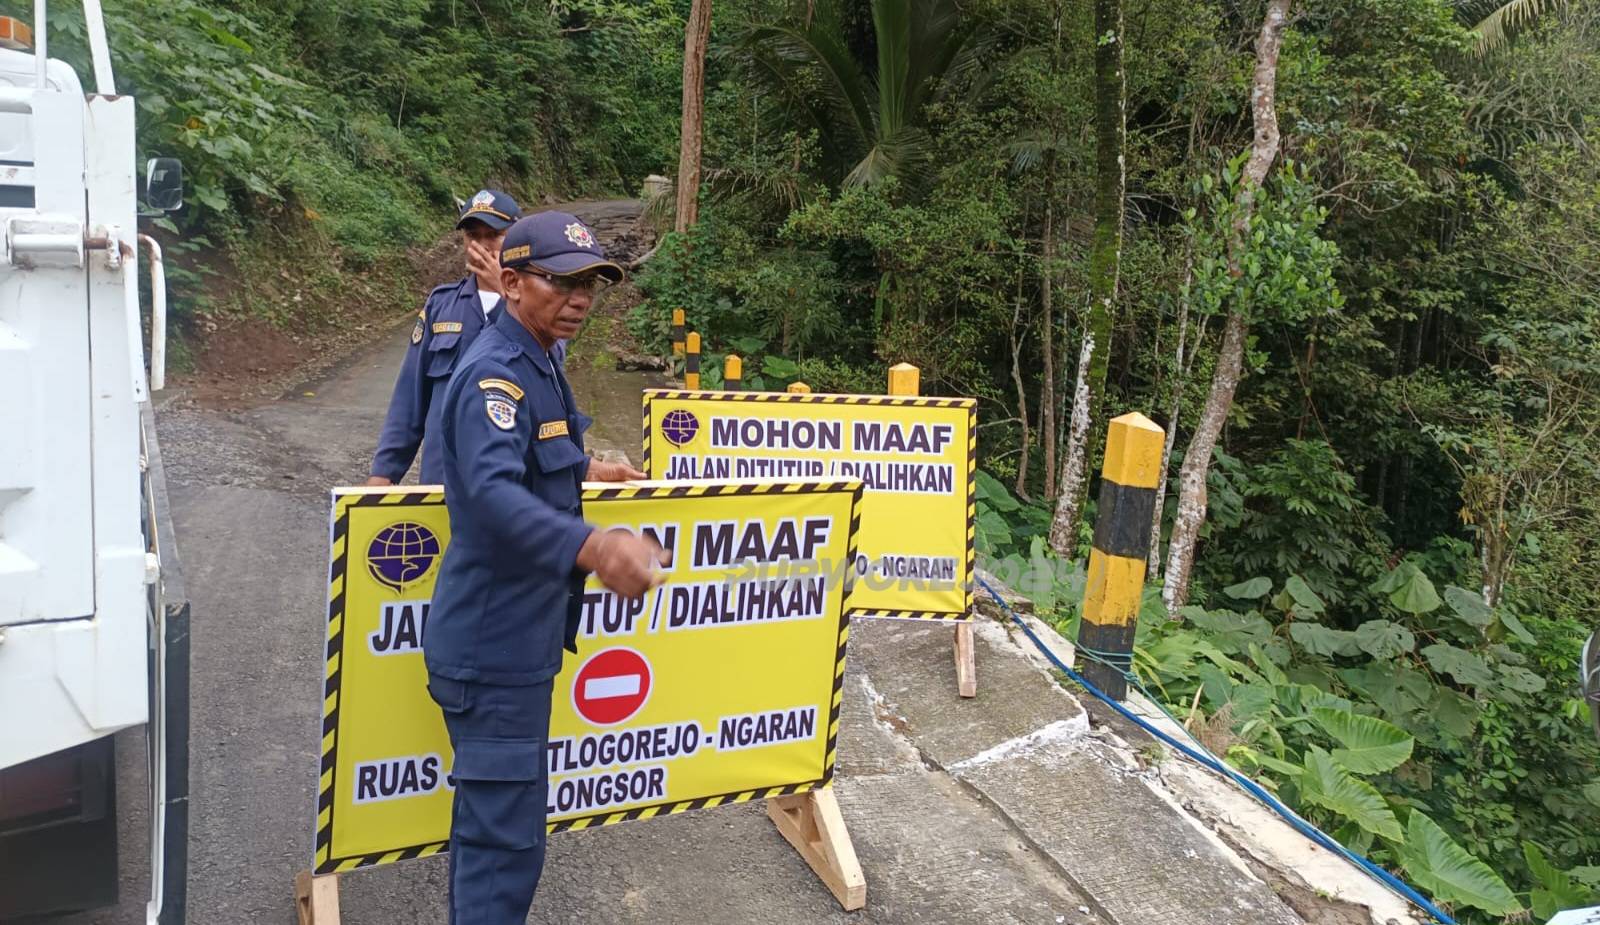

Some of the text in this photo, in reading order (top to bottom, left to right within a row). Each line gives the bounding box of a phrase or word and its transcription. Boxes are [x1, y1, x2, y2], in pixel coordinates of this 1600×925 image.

[712, 418, 952, 454] MOHON MAAF
[665, 456, 729, 480] JALAN
[694, 519, 831, 567] MAAF
[883, 556, 954, 580] NGARAN
[651, 587, 663, 630] /
[669, 577, 825, 628] DIALIHKAN
[547, 723, 699, 773] TLOGOREJO
[719, 708, 815, 749] NGARAN
[357, 756, 439, 800] RUAS
